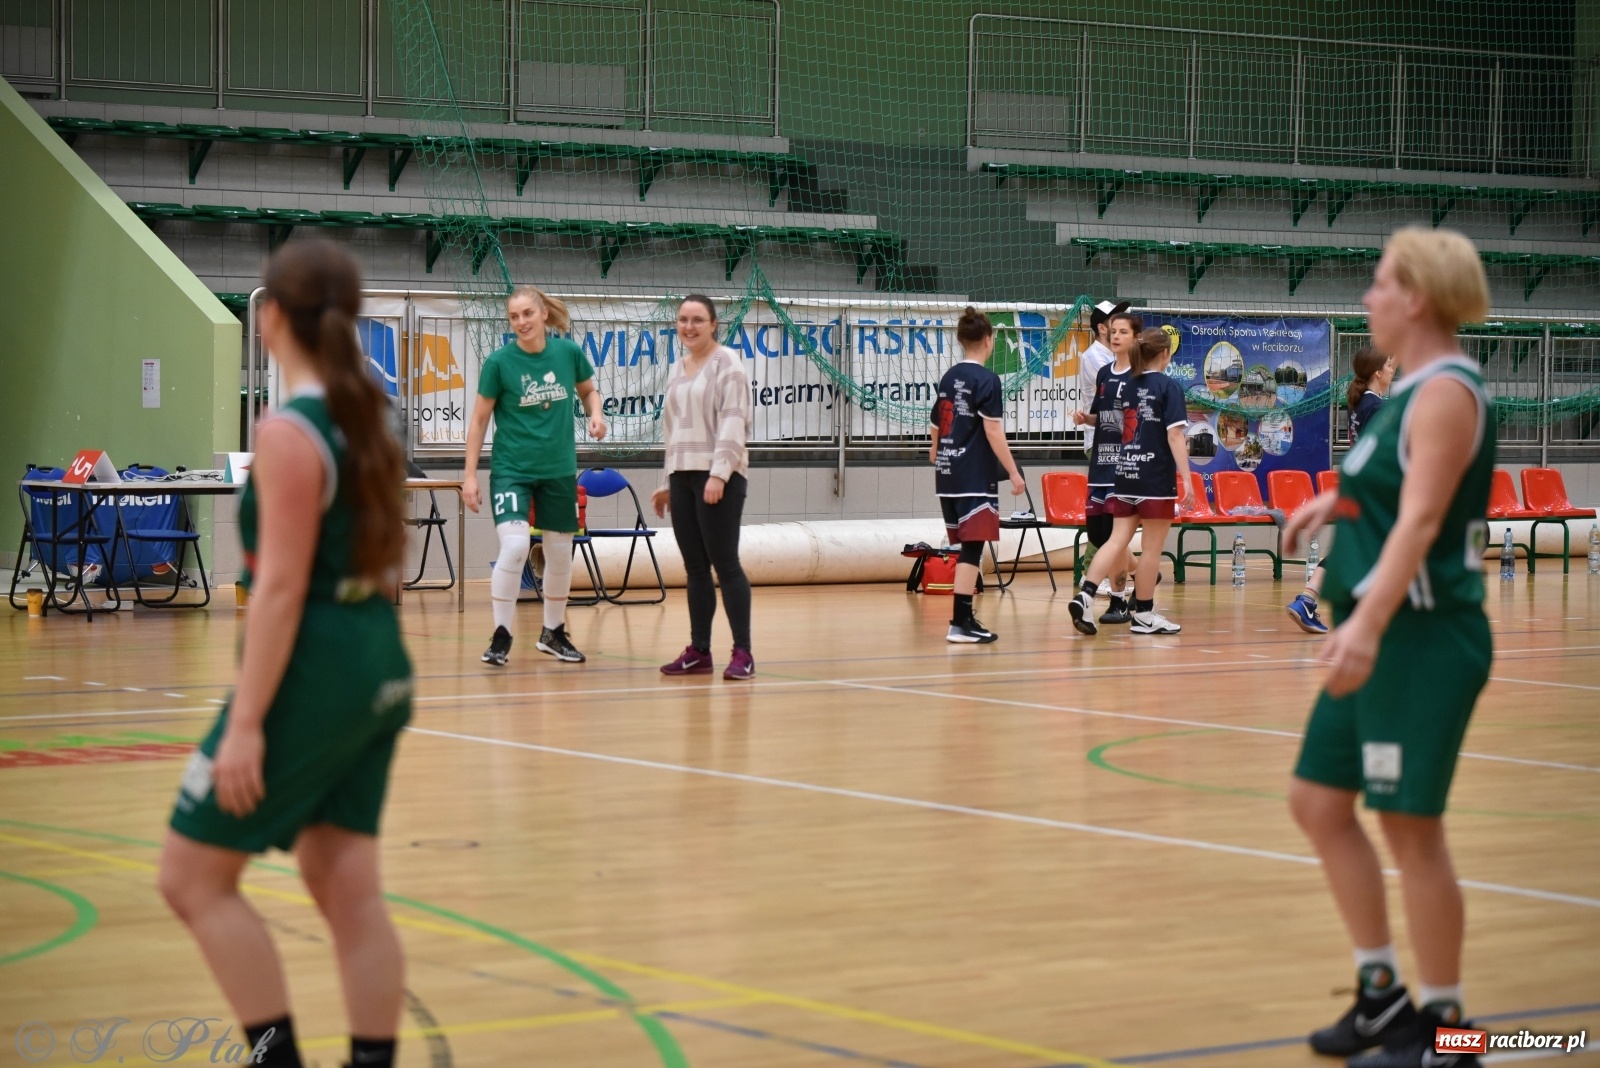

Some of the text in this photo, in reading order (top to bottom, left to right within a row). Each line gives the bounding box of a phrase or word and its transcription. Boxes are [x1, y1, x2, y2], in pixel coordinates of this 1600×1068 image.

[1228, 326, 1256, 339] Sportu
[503, 328, 678, 367] WIAT
[1262, 341, 1304, 352] Raciborzu
[520, 388, 568, 404] BASKETBALL
[495, 491, 518, 515] 27
